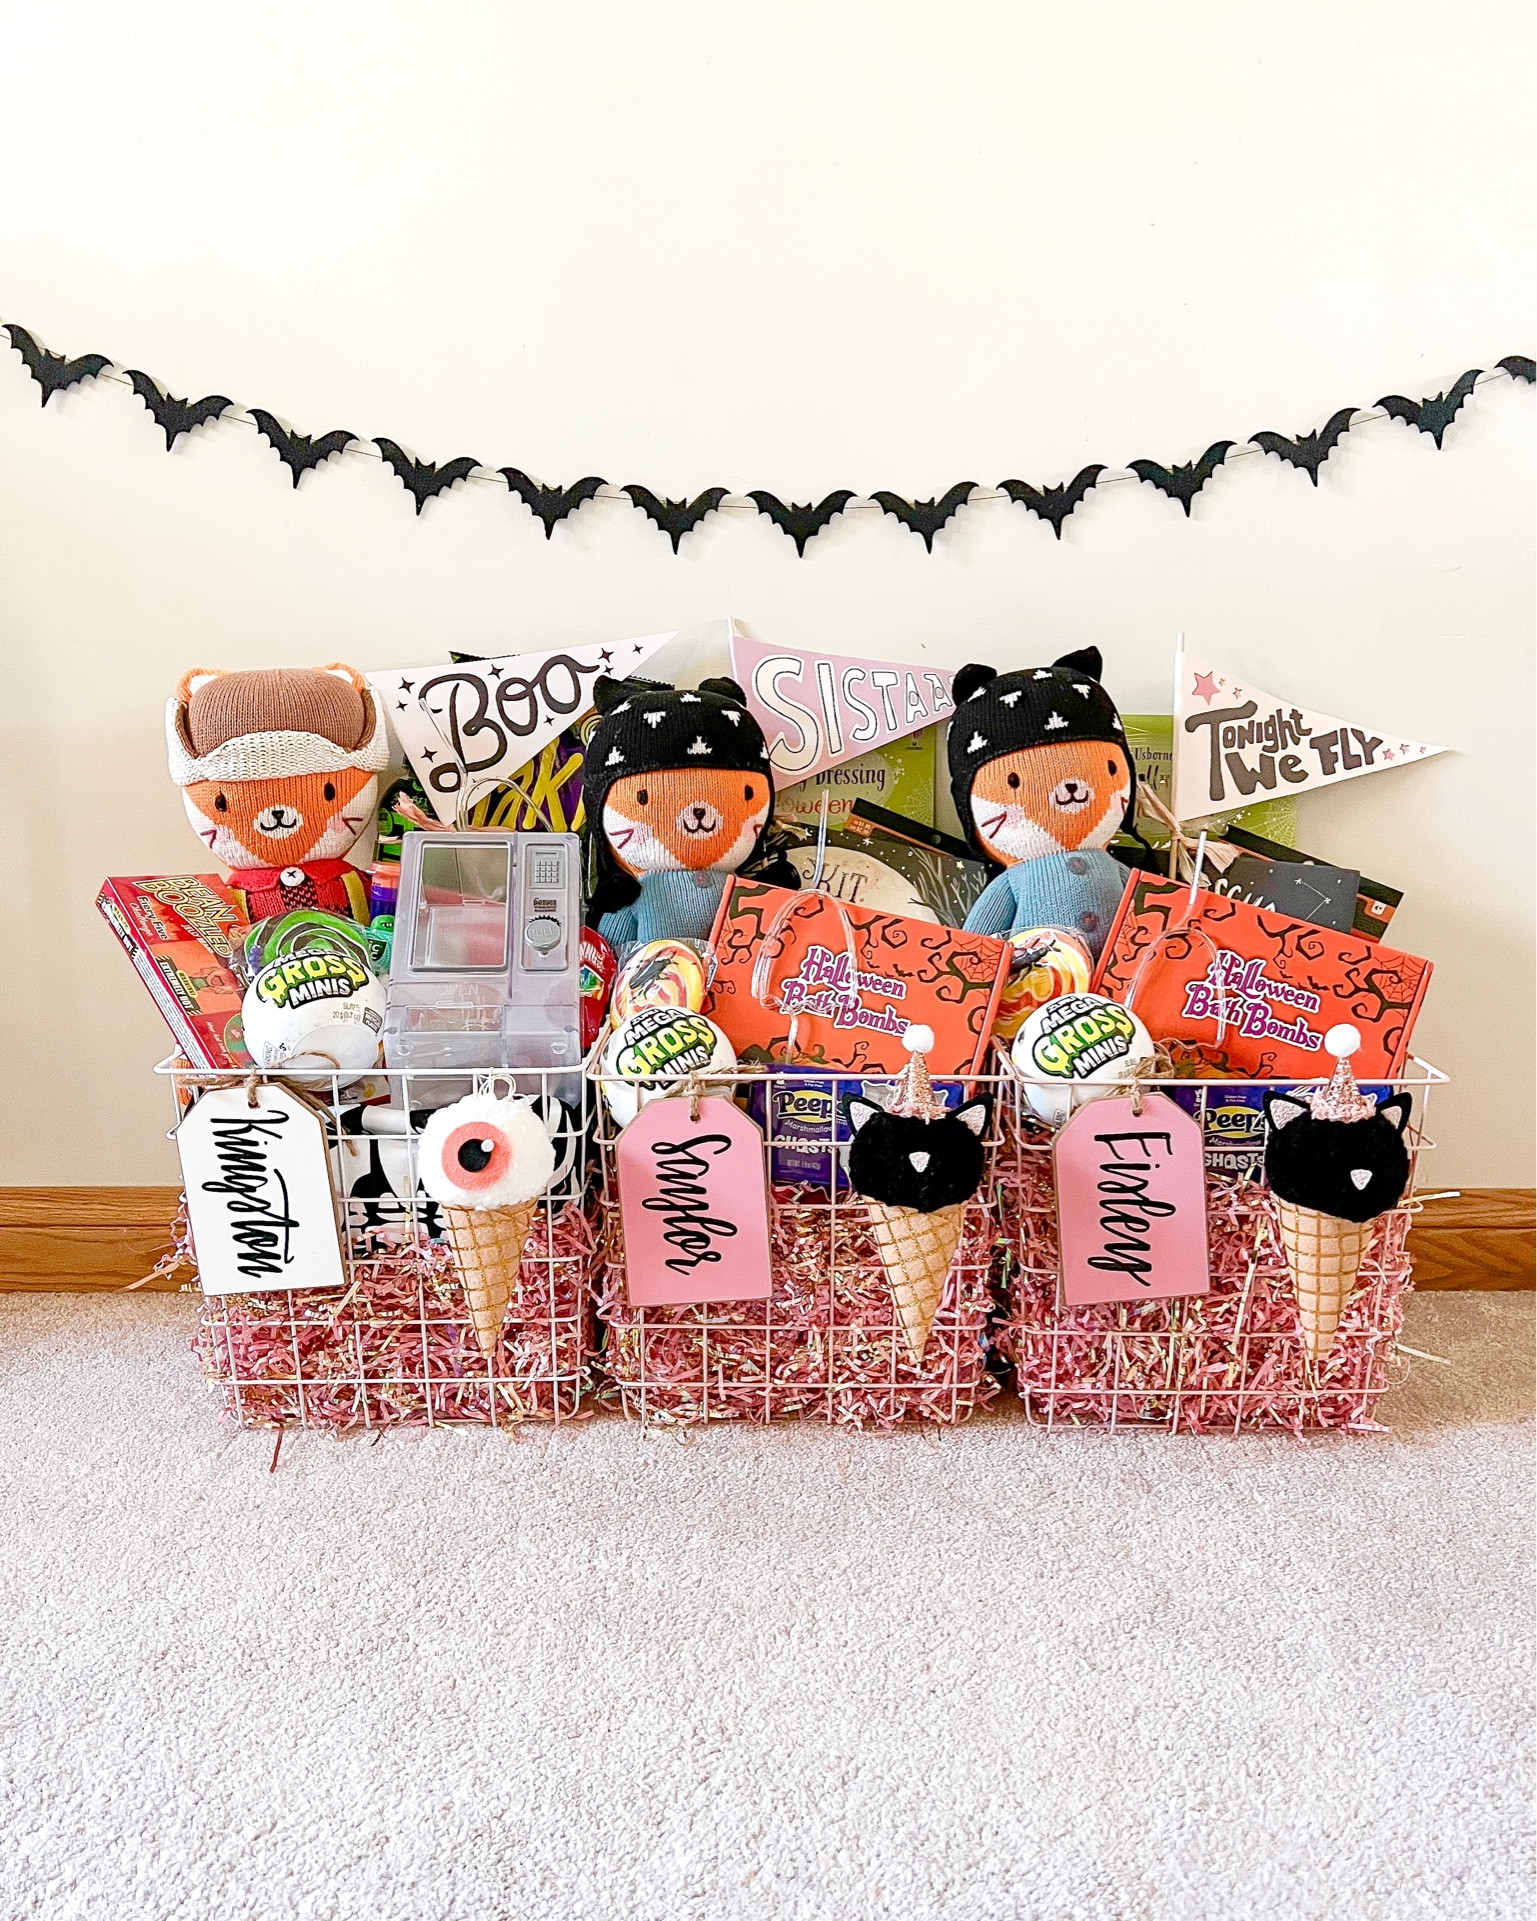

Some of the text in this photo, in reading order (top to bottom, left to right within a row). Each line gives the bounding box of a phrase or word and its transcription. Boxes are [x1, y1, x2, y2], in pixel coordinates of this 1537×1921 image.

[418, 655, 600, 793] Boo
[754, 655, 954, 772] SISTAA
[1310, 728, 1384, 776] FLY
[133, 880, 233, 957] BOOZLED
[138, 896, 169, 940] Fiery Five
[167, 876, 239, 921] BEAN
[257, 954, 368, 1005] GROSS
[290, 978, 351, 1006] MINIS
[1208, 952, 1319, 1011] Halloween
[625, 1008, 684, 1045] MEGA
[836, 994, 909, 1035] Bombs
[1041, 997, 1104, 1034] MEGA
[1243, 1002, 1321, 1048] Bombs
[617, 1016, 716, 1086] GROSS
[1033, 1004, 1134, 1078] GROSS
[1073, 1035, 1128, 1078] MINIS
[655, 1045, 710, 1088] MINIS
[202, 1109, 300, 1279] Kingston
[641, 1133, 739, 1276] Saylor
[1087, 1131, 1177, 1287] Eisley
